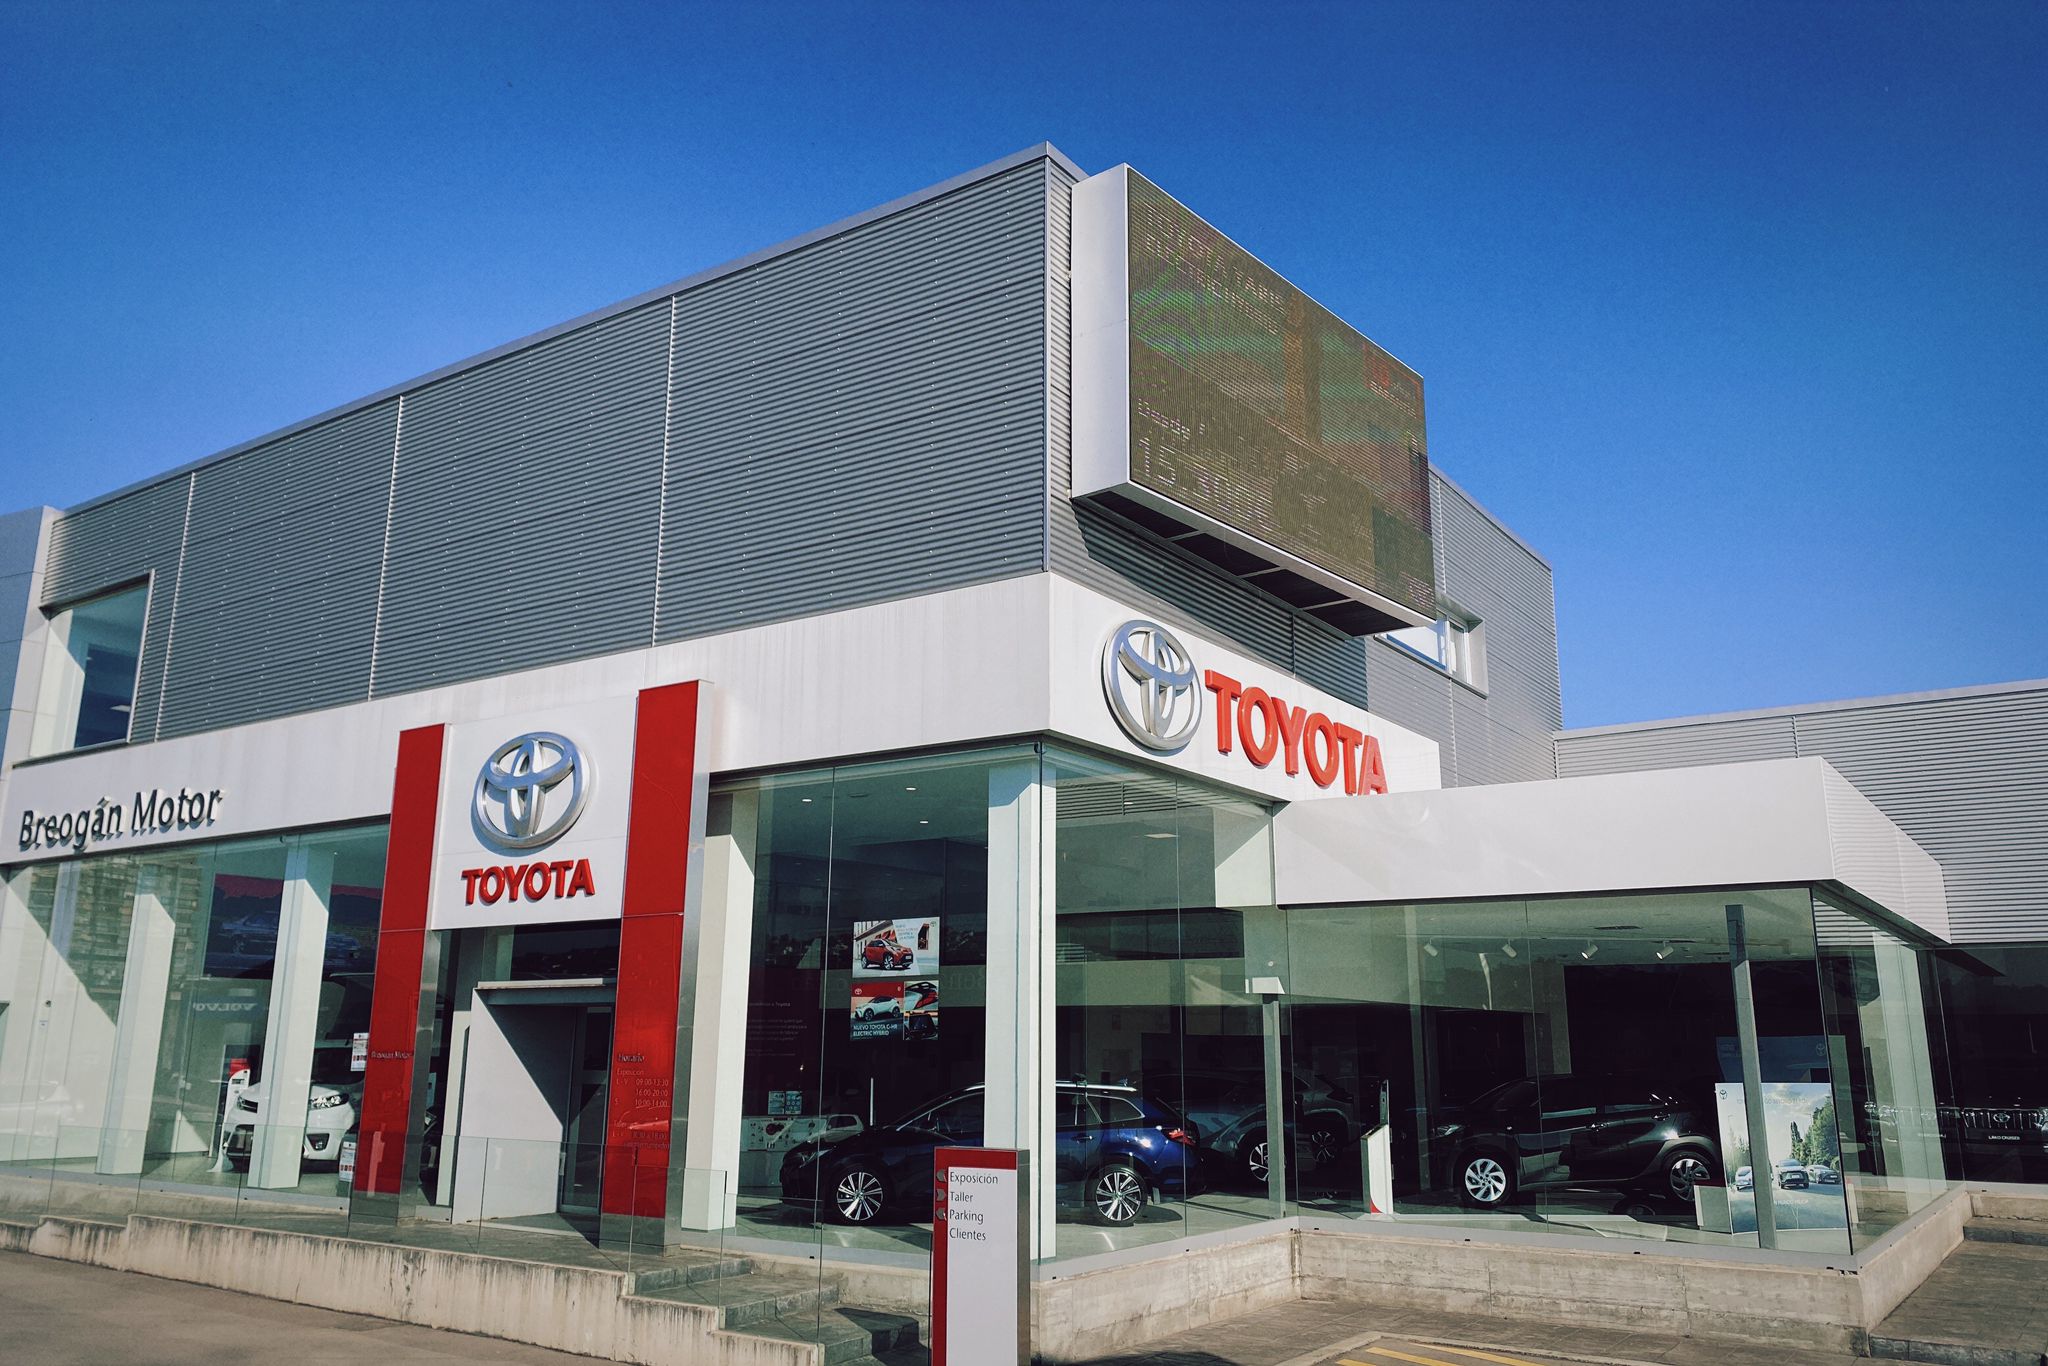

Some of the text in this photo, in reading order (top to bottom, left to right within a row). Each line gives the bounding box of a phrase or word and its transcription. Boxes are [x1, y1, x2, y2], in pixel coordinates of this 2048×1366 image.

[1204, 669, 1389, 796] TOYOTA
[19, 788, 223, 850] Breogán Motor
[461, 858, 595, 905] TOYOTA
[949, 1171, 999, 1186] Exposición
[950, 1191, 974, 1203] Taller
[949, 1208, 984, 1225] Parking
[949, 1227, 987, 1241] Clientes
